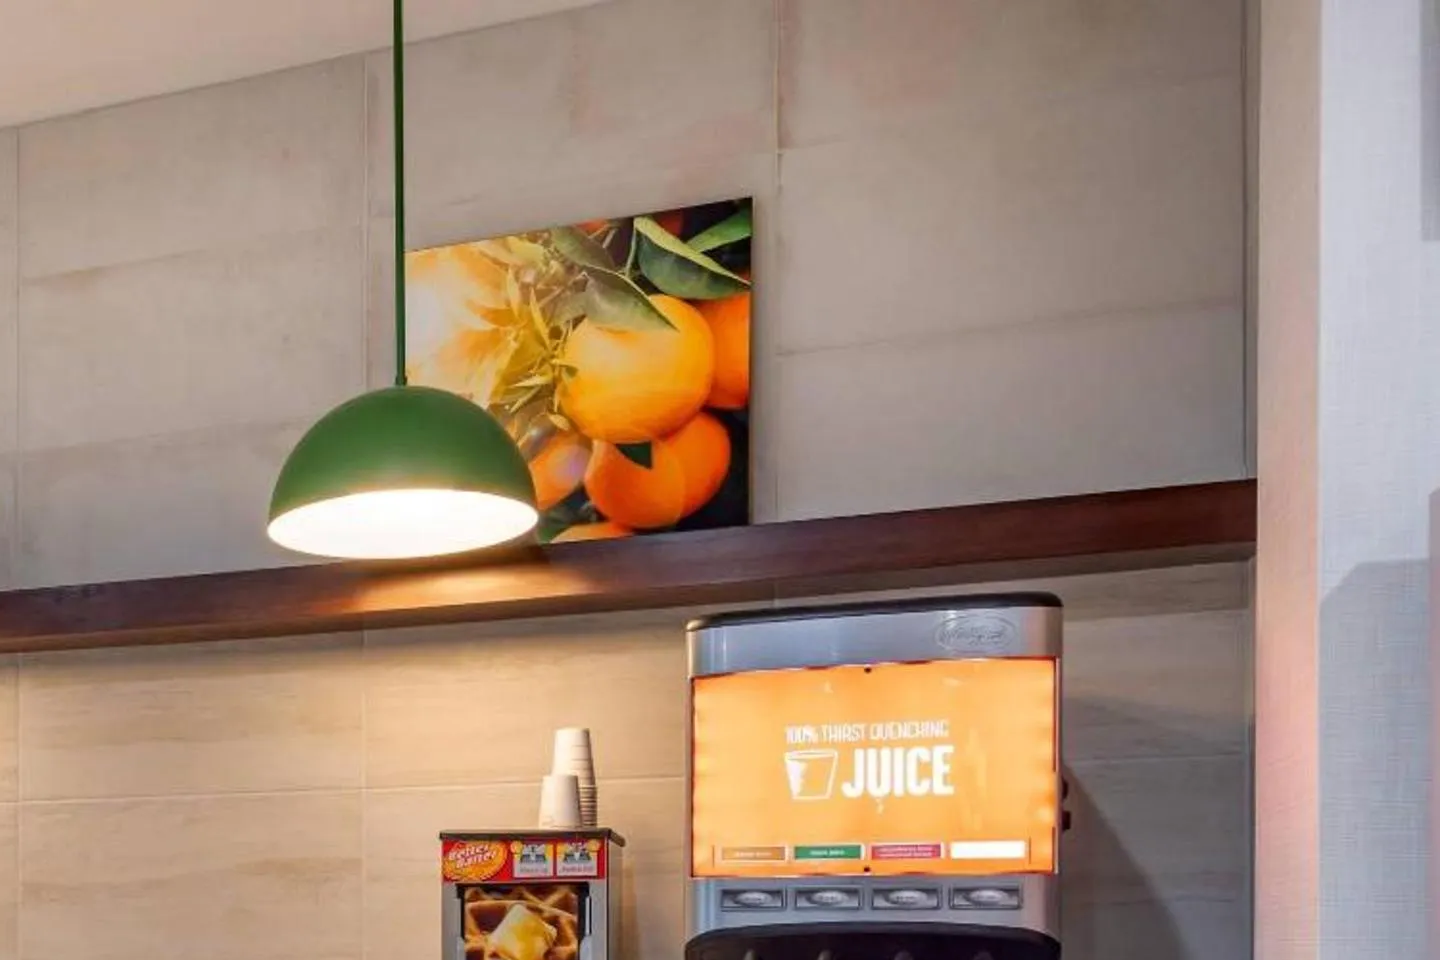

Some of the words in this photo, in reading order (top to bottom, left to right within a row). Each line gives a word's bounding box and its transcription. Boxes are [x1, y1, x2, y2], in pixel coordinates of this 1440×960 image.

[821, 722, 866, 744] THIRST
[869, 719, 950, 741] QUENCHING
[841, 745, 955, 798] JUICE
